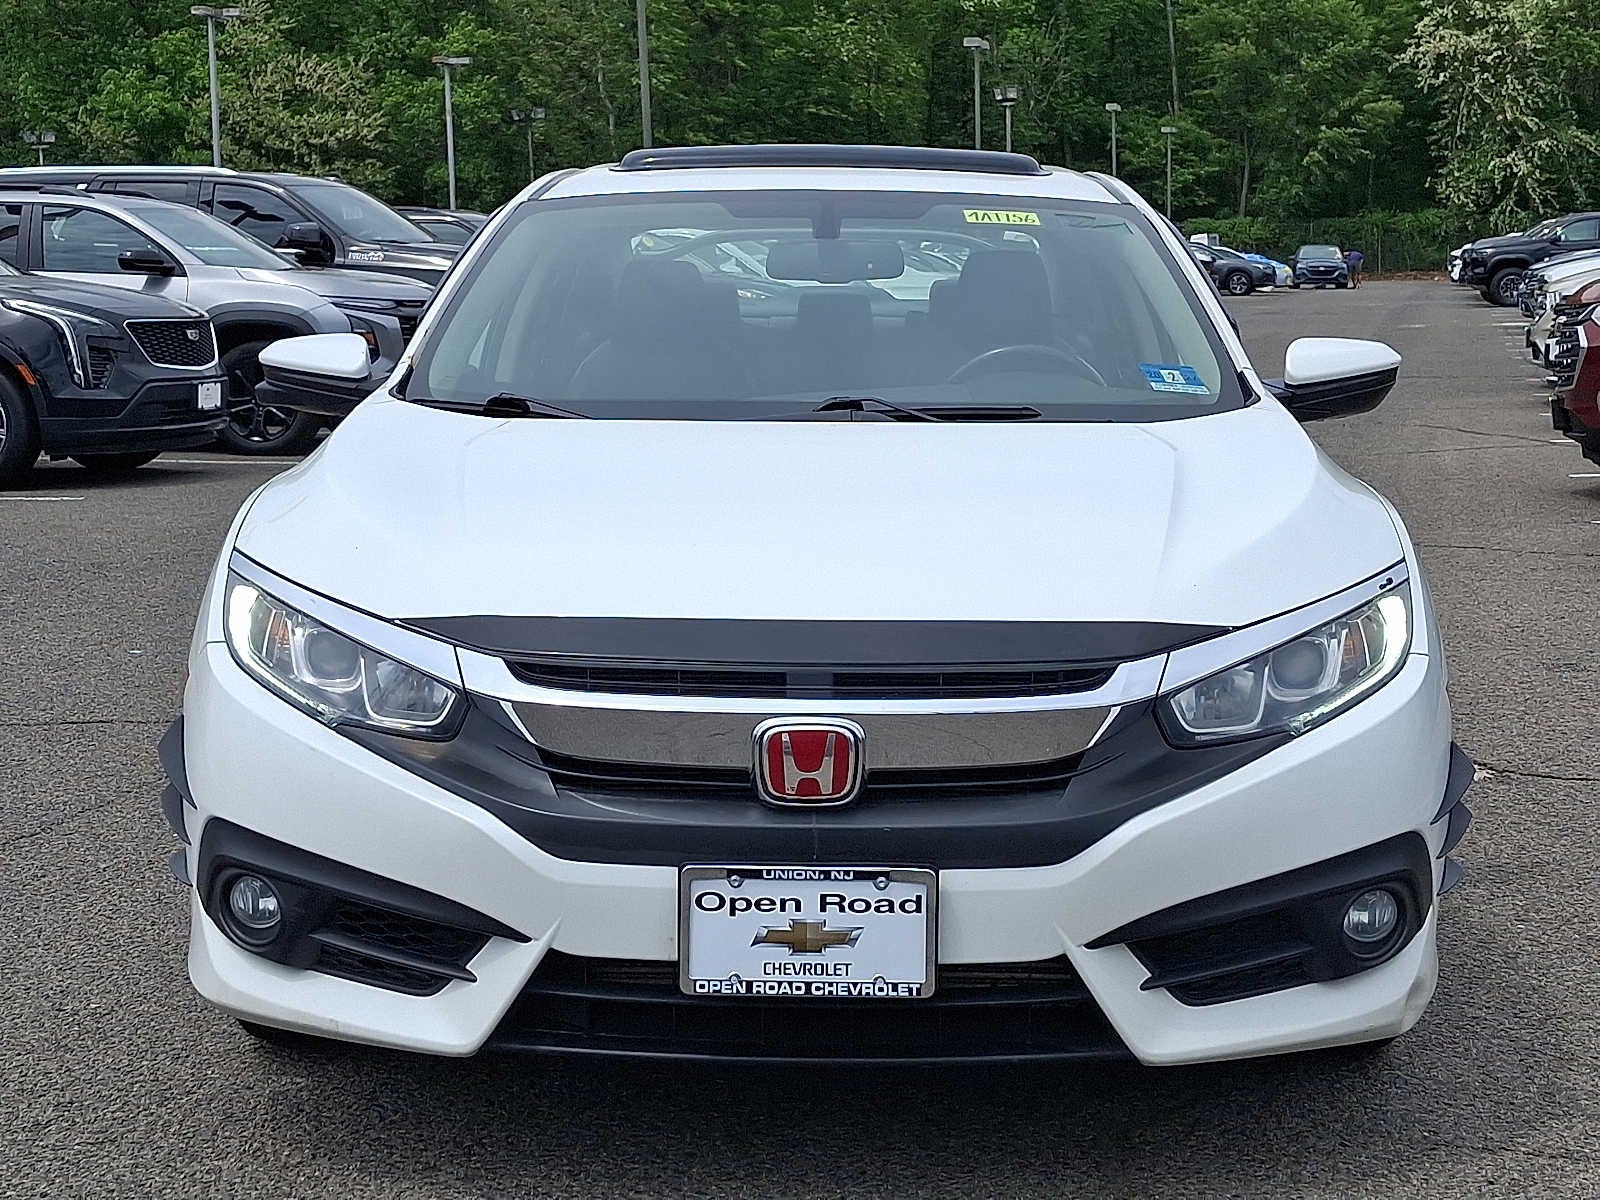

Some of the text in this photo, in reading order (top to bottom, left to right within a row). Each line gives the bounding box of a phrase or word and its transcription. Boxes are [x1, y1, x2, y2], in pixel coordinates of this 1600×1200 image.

[1167, 371, 1180, 382] 2
[762, 869, 854, 880] UNION, NJ
[694, 891, 923, 917] Open Road
[763, 962, 853, 977] CHEVROLET
[695, 980, 921, 997] OPEN ROAD CHEVROLET
